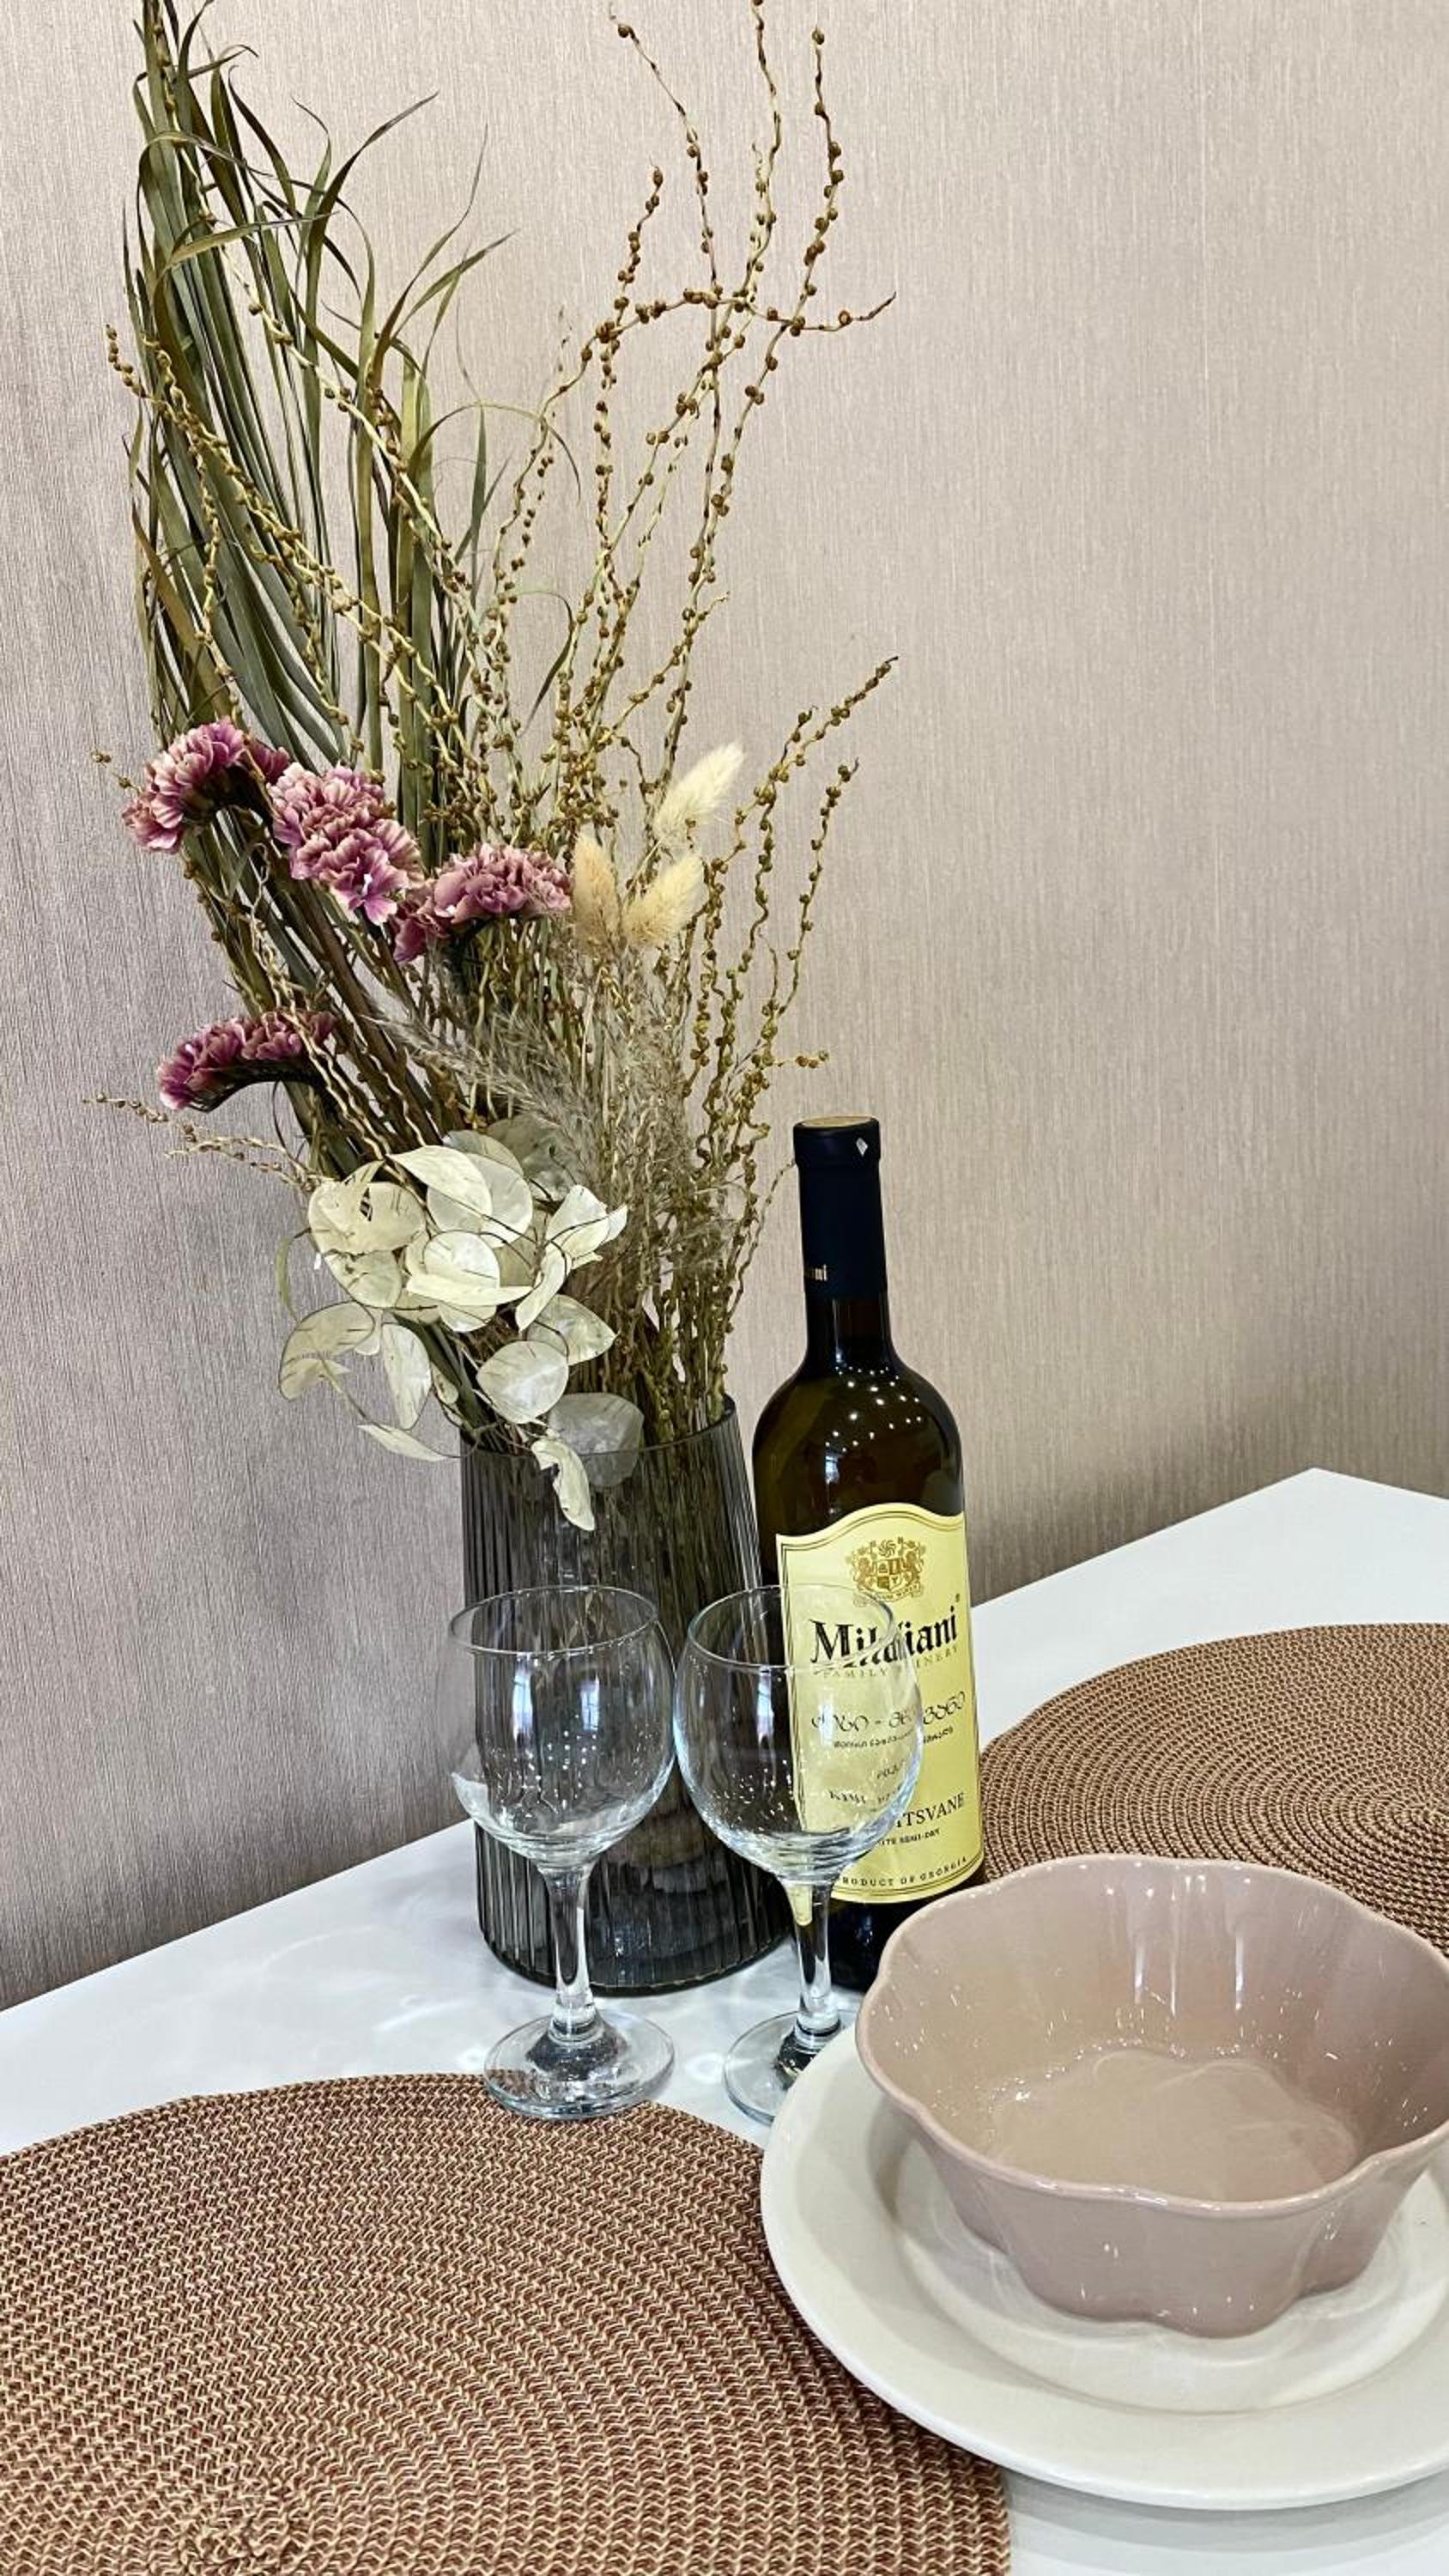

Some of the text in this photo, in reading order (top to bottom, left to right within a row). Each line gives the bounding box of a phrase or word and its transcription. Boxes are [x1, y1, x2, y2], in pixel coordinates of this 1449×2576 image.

[896, 1791, 964, 1828] TSVANE
[841, 1856, 967, 1887] RODUCT OF GEORGIA
